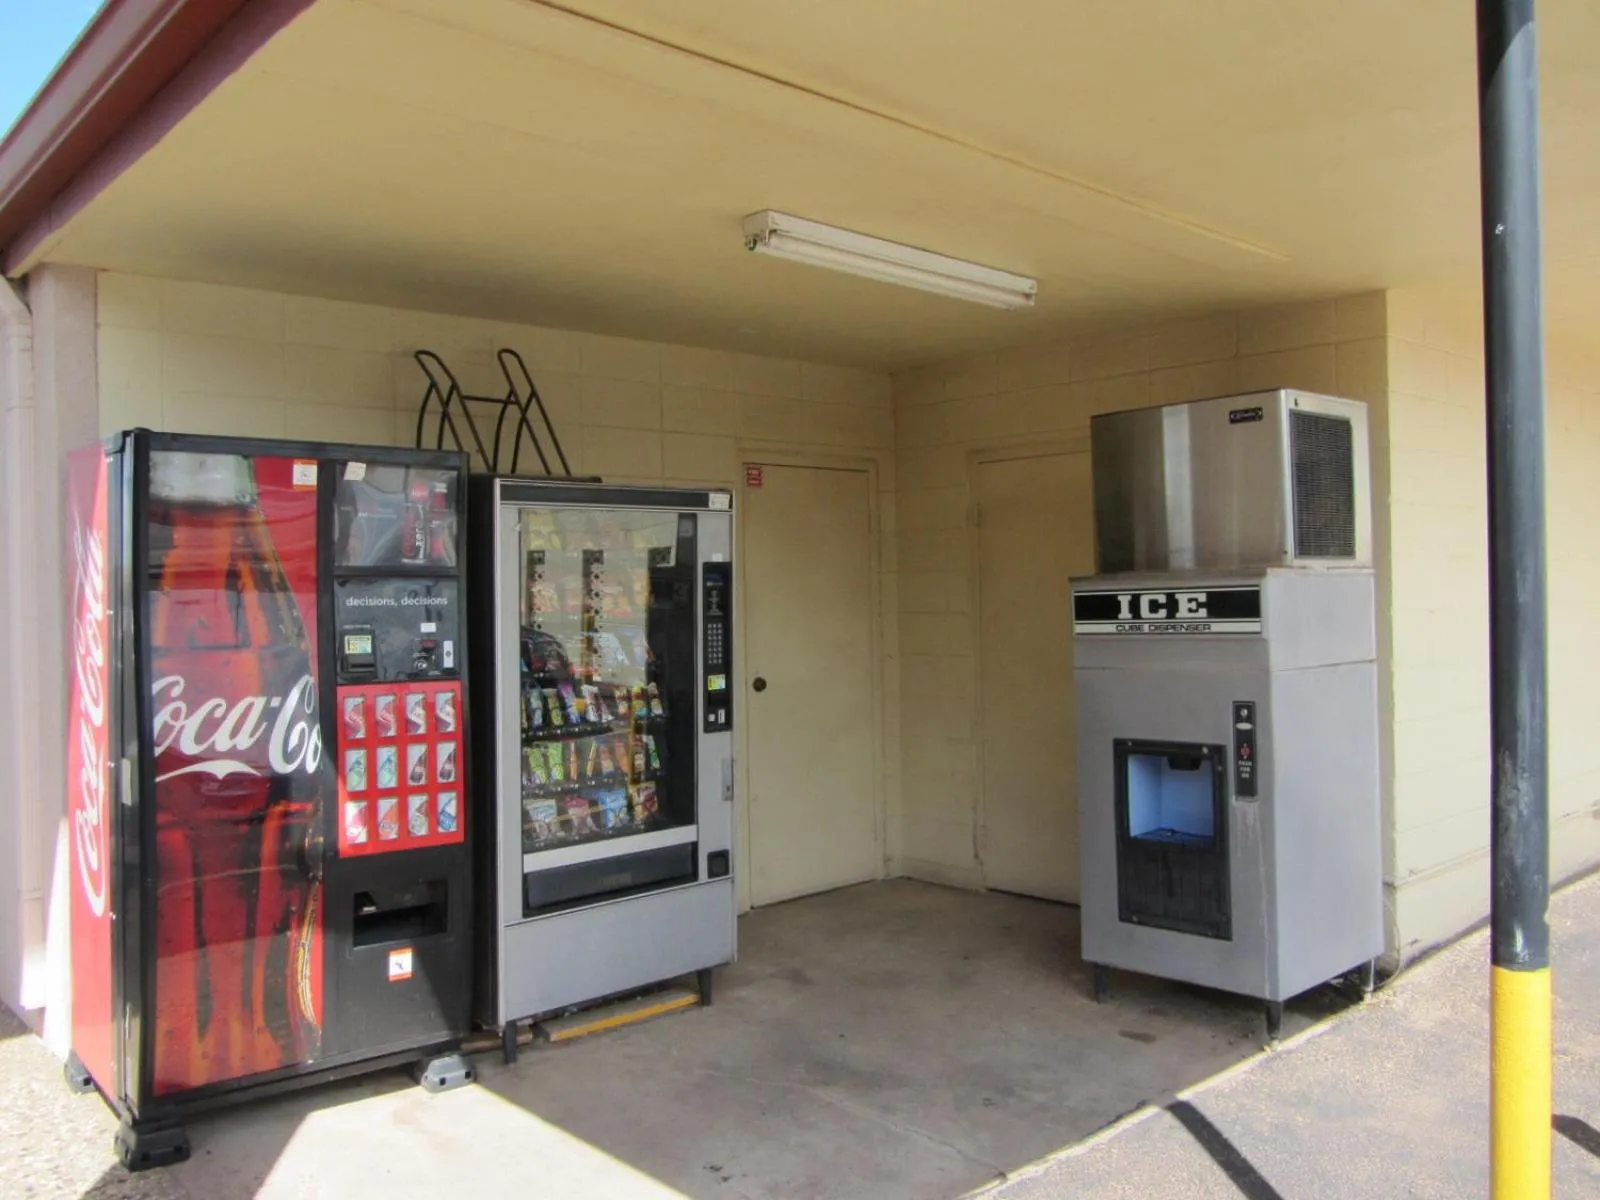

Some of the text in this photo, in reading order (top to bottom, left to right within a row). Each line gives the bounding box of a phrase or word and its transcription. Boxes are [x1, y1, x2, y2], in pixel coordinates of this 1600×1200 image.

[345, 594, 448, 607] decisions, decisions
[1117, 592, 1208, 620] ICE
[1115, 623, 1212, 633] CUBE DISPENSER
[74, 507, 105, 918] Coca-Cola
